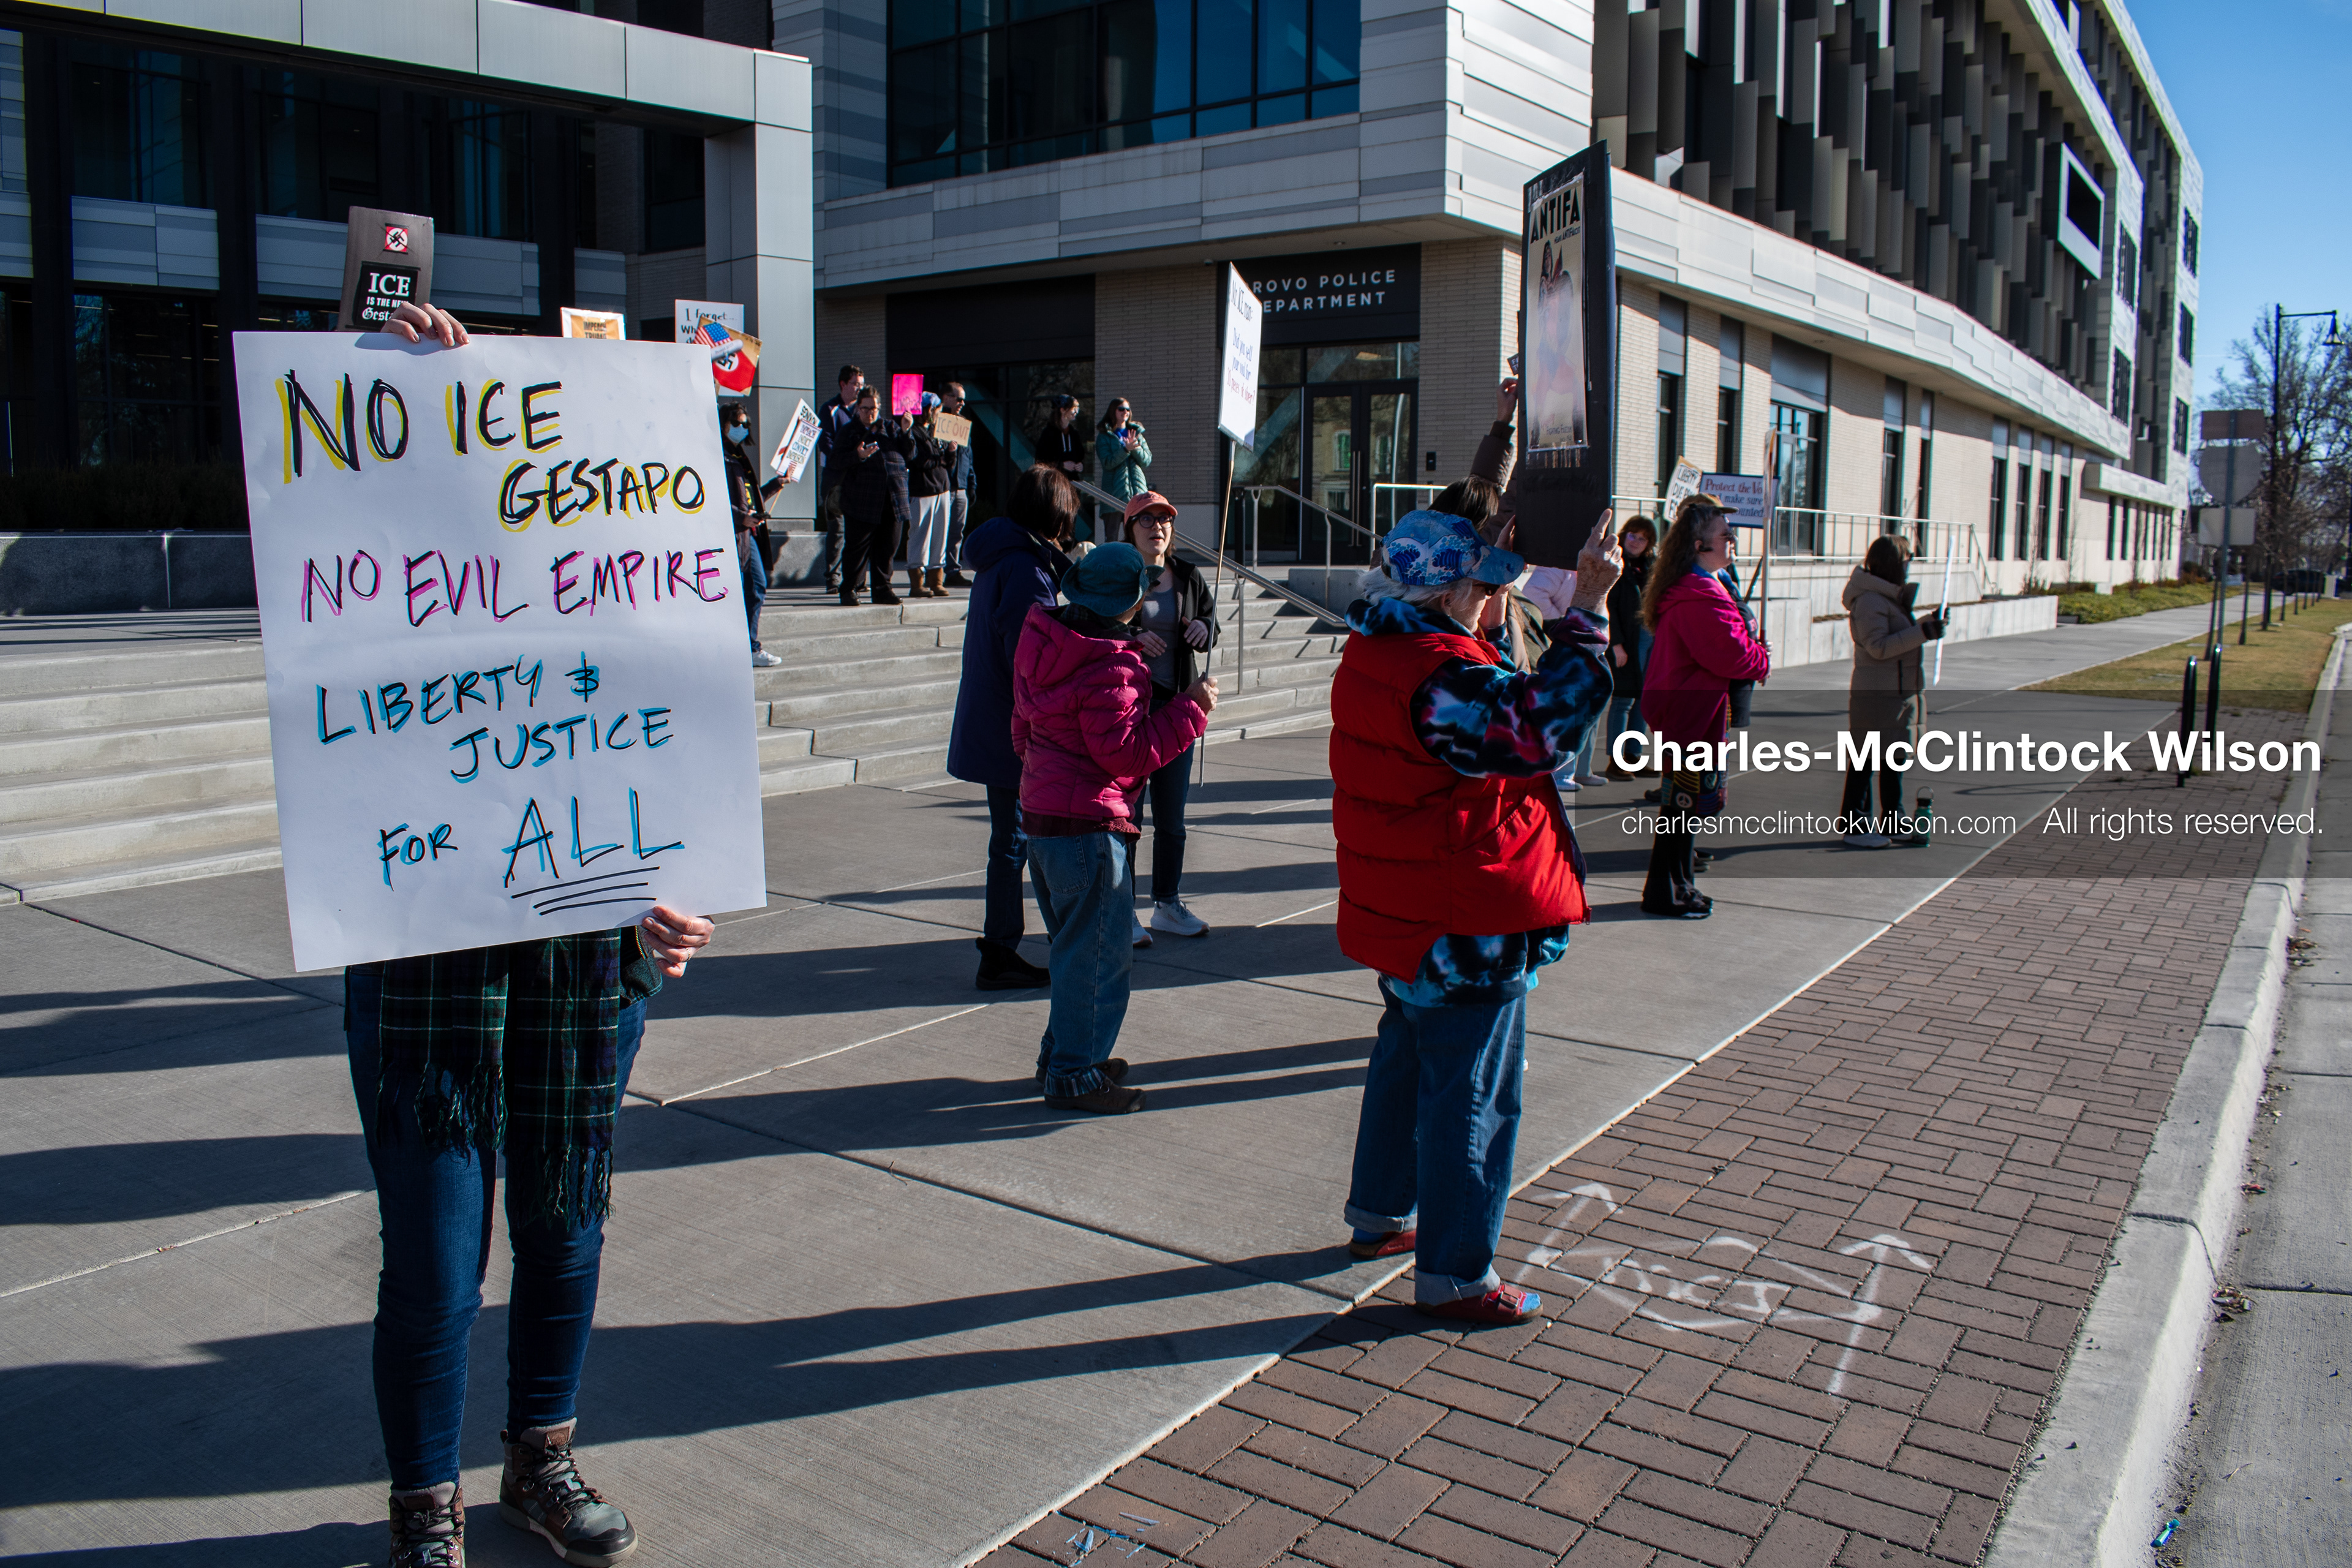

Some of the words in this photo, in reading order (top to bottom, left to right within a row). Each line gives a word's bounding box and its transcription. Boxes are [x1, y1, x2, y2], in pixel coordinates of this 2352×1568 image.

[1531, 187, 1580, 244] ANTIFA
[368, 272, 411, 298] ICE
[1253, 277, 1307, 294] ROVO
[1319, 270, 1395, 288] POLICE
[361, 306, 393, 322] Gest
[366, 296, 375, 305] IS
[377, 298, 390, 307] THE
[391, 299, 409, 308] NE
[1264, 291, 1385, 313] EPARTMENT
[584, 321, 606, 331] IMPEACH
[275, 369, 409, 484] NO
[445, 377, 564, 456] ICE
[937, 417, 951, 434] ICE
[952, 423, 969, 440] OUT
[1678, 467, 1698, 486] LIBERTY
[1705, 478, 1735, 491] Protect
[1738, 481, 1752, 493] the
[1752, 481, 1763, 494] Vo
[499, 458, 705, 532] GESTAPO
[1725, 493, 1744, 503] make
[1747, 496, 1763, 505] sure
[302, 549, 381, 622] NO
[403, 549, 530, 627] EVIL
[550, 547, 729, 617] EMPIRE
[317, 653, 543, 745] LIBERTY
[450, 707, 674, 784] JUSTICE
[377, 823, 459, 892] FOR
[501, 786, 685, 889] ALL
